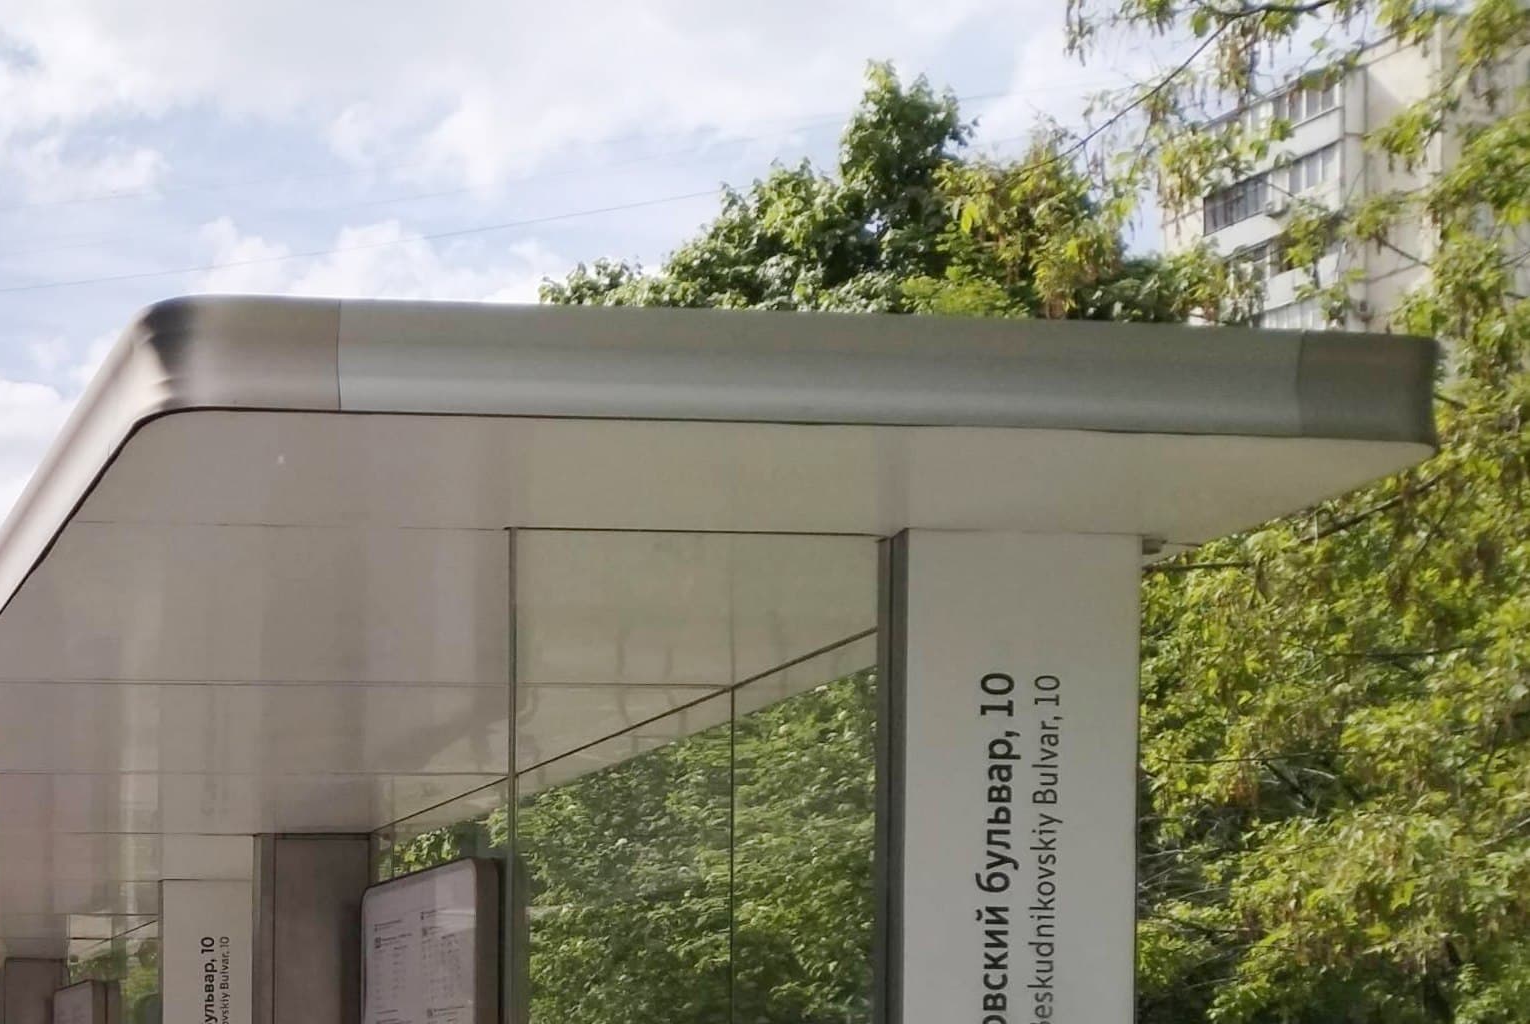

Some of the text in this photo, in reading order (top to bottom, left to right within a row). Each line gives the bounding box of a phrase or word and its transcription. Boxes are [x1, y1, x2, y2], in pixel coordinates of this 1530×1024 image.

[978, 671, 1016, 719] 10
[1034, 674, 1062, 707] 10
[1032, 714, 1065, 806] Bulvar,
[976, 728, 1021, 893] бульвар,
[201, 936, 215, 954] 10
